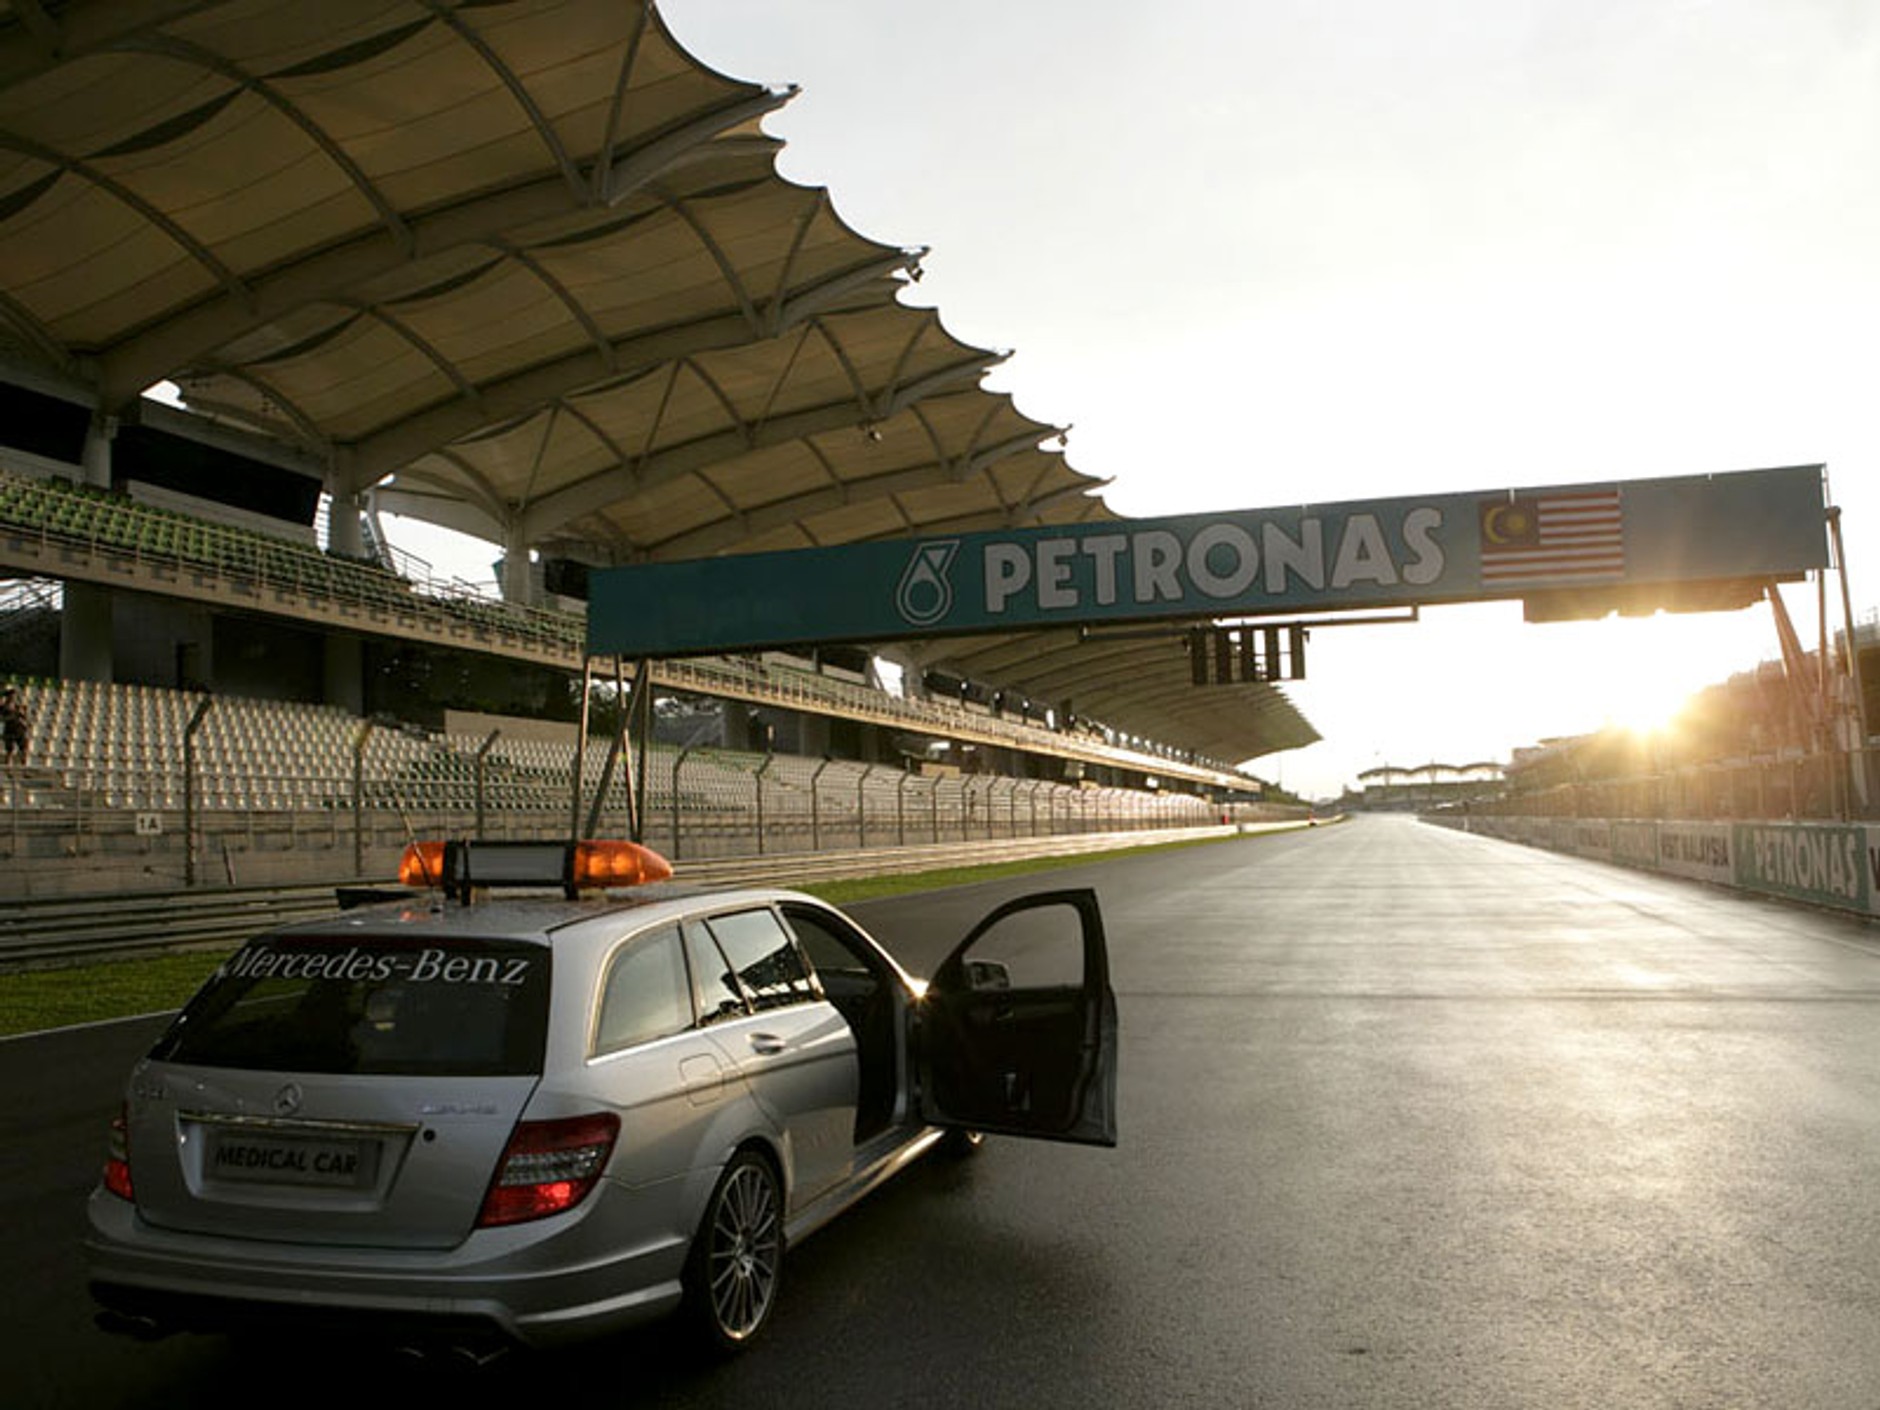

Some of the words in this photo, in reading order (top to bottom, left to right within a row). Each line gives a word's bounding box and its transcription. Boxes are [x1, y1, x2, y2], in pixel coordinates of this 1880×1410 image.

[984, 507, 1445, 613] PETRONAS
[139, 817, 158, 830] 1A
[1752, 828, 1858, 899] PETRONAS
[216, 947, 529, 985] Mercedes-Benz
[215, 1146, 307, 1172] MEDICAL
[313, 1152, 359, 1175] CAR
